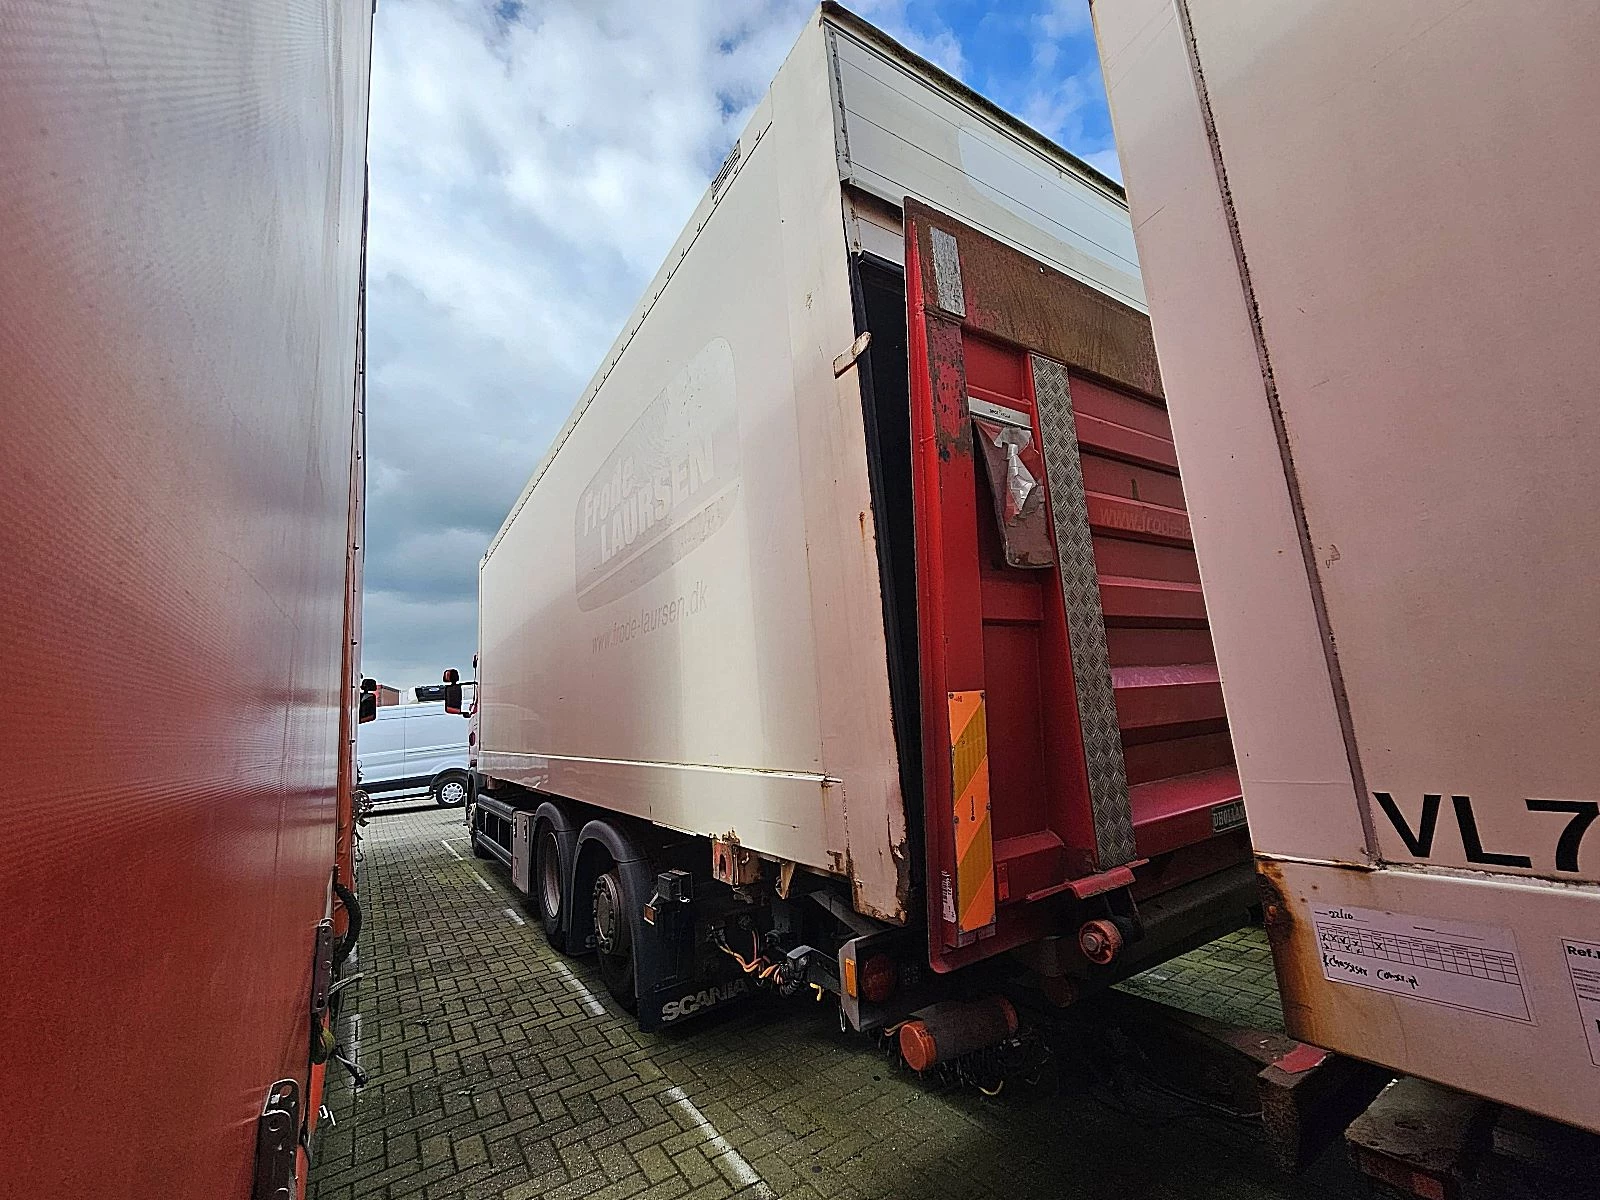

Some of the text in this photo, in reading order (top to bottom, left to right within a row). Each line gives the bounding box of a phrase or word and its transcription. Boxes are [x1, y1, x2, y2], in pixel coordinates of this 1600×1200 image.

[584, 456, 635, 537] Frode
[600, 432, 714, 565] LAURSEN
[591, 579, 709, 655] www.frode-laursen.dk
[1372, 792, 1600, 873] VL7
[661, 977, 749, 1022] SCANIA
